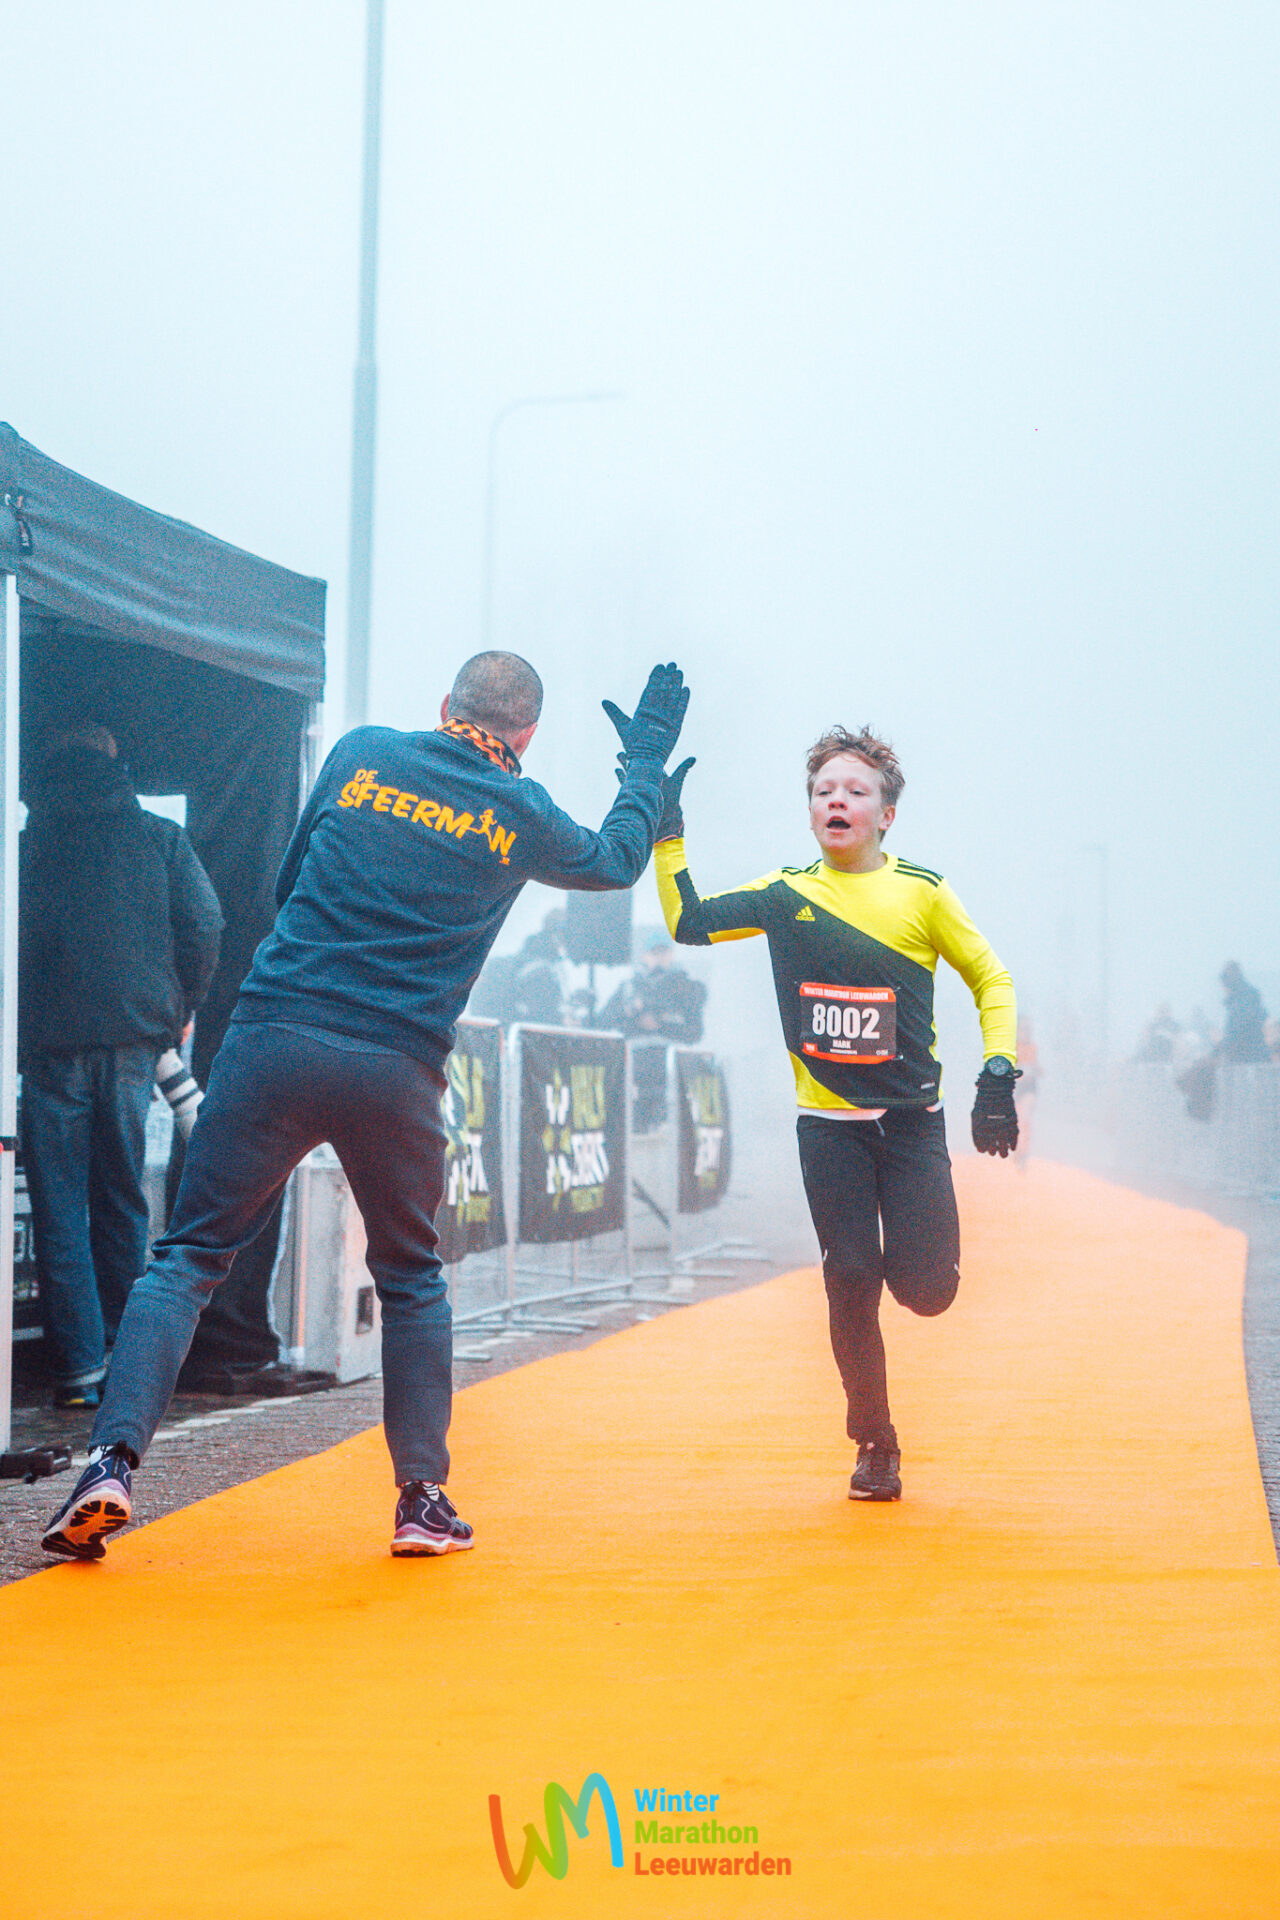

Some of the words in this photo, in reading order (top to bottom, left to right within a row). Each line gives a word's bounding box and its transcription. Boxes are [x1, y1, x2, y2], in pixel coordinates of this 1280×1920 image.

[354, 769, 378, 784] DE
[812, 1003, 880, 1039] 8002
[832, 1039, 852, 1049] MARK
